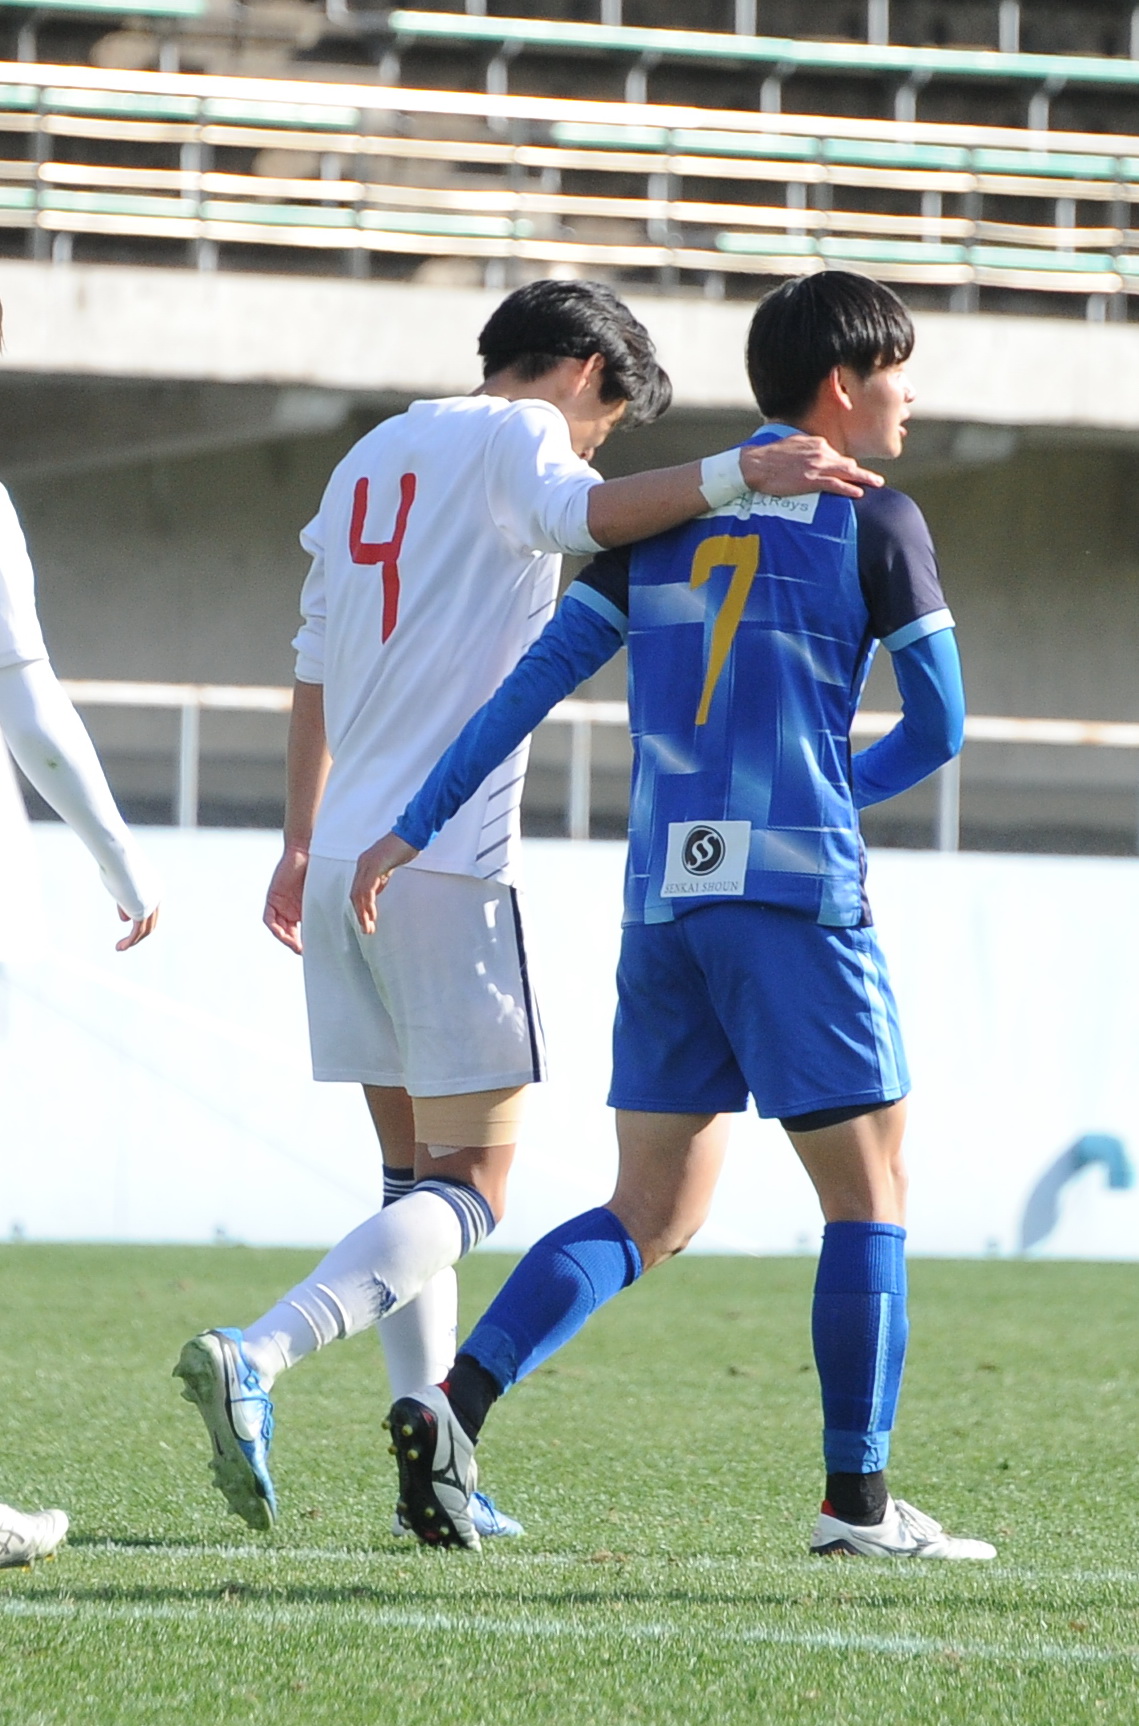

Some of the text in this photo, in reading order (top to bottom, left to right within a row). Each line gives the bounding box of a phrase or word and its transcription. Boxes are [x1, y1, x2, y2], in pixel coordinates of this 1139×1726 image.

[349, 472, 416, 645] 4
[689, 533, 761, 726] 7
[664, 880, 739, 894] SENKAI SHOUN
